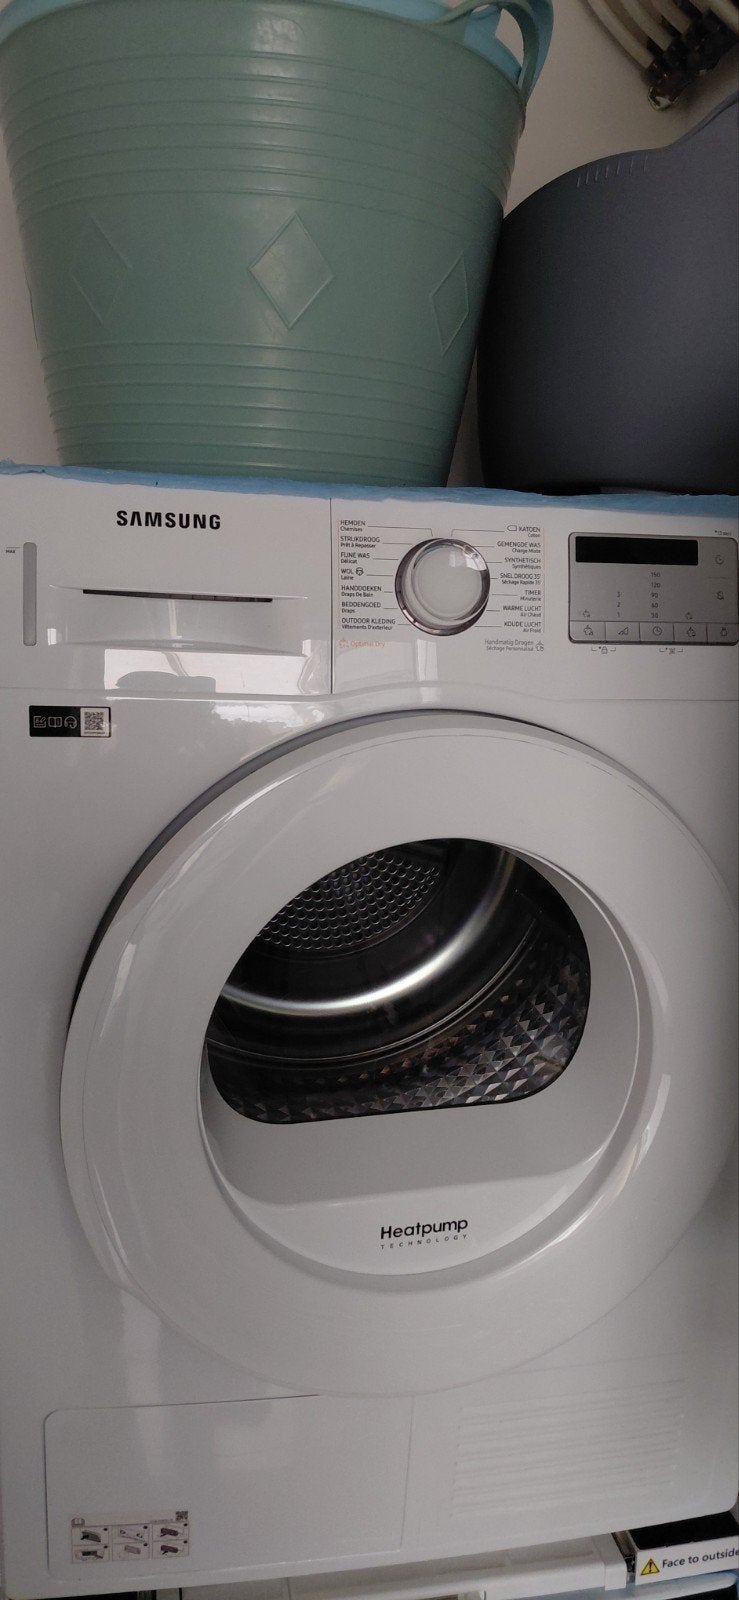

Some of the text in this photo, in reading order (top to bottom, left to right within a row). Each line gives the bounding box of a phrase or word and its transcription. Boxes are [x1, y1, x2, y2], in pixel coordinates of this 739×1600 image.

[116, 510, 221, 530] SAMSUNG
[381, 1219, 468, 1239] Heatpump
[381, 1234, 467, 1250] TECHNOLOGY
[663, 1558, 685, 1568] Face
